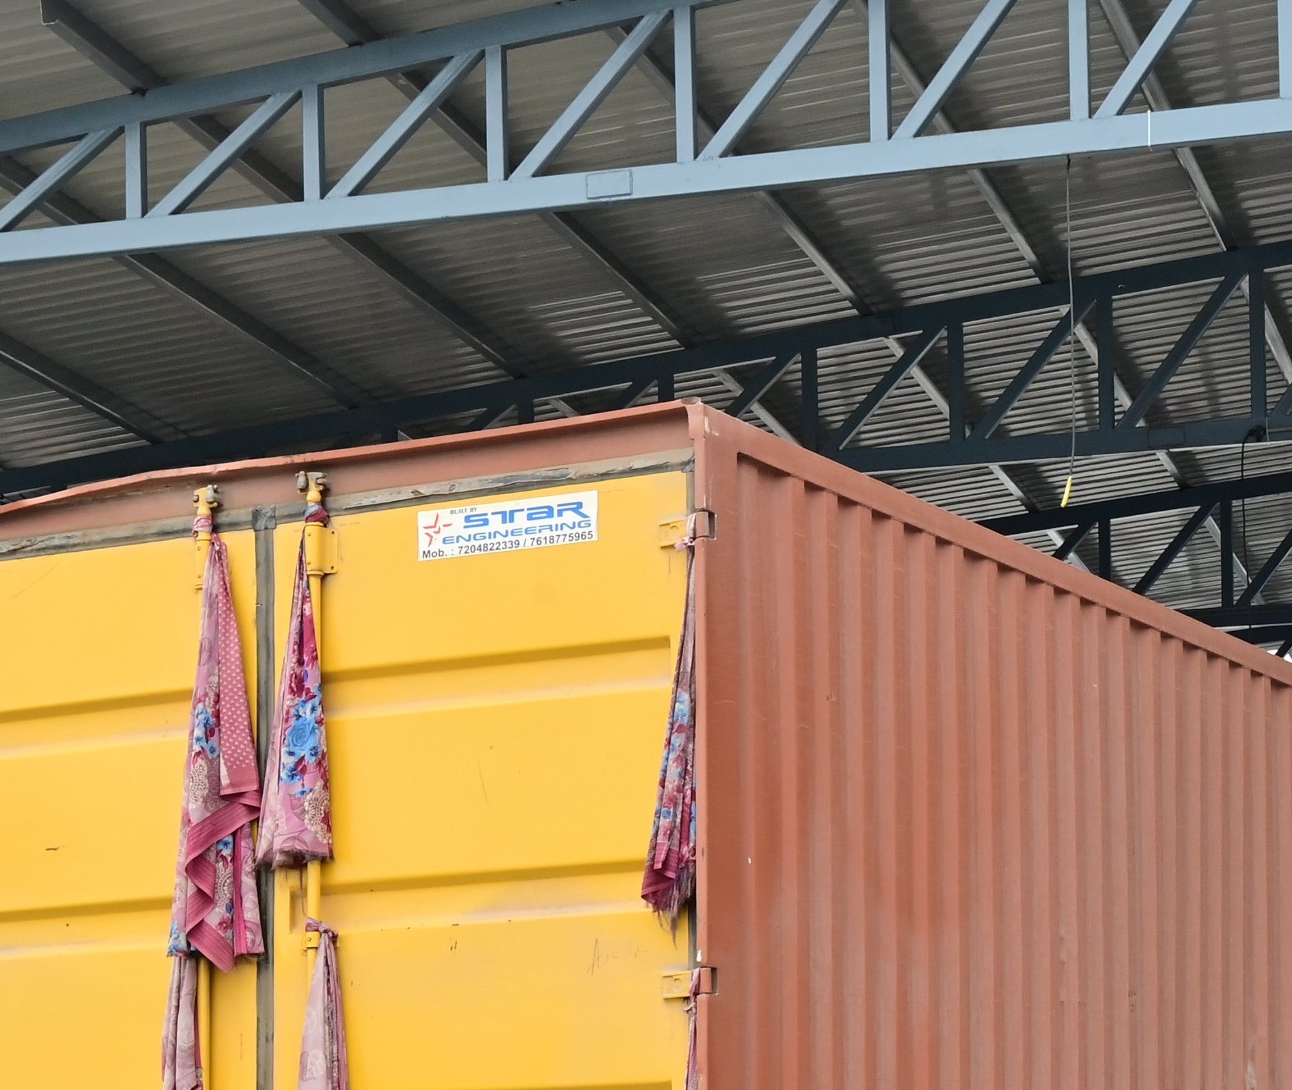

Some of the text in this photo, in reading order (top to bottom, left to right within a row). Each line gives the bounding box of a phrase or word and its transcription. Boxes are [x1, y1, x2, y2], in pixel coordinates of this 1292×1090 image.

[442, 519, 591, 545] ENGINEERING
[458, 540, 520, 555] 7204822339
[530, 530, 594, 547] 7618775965
